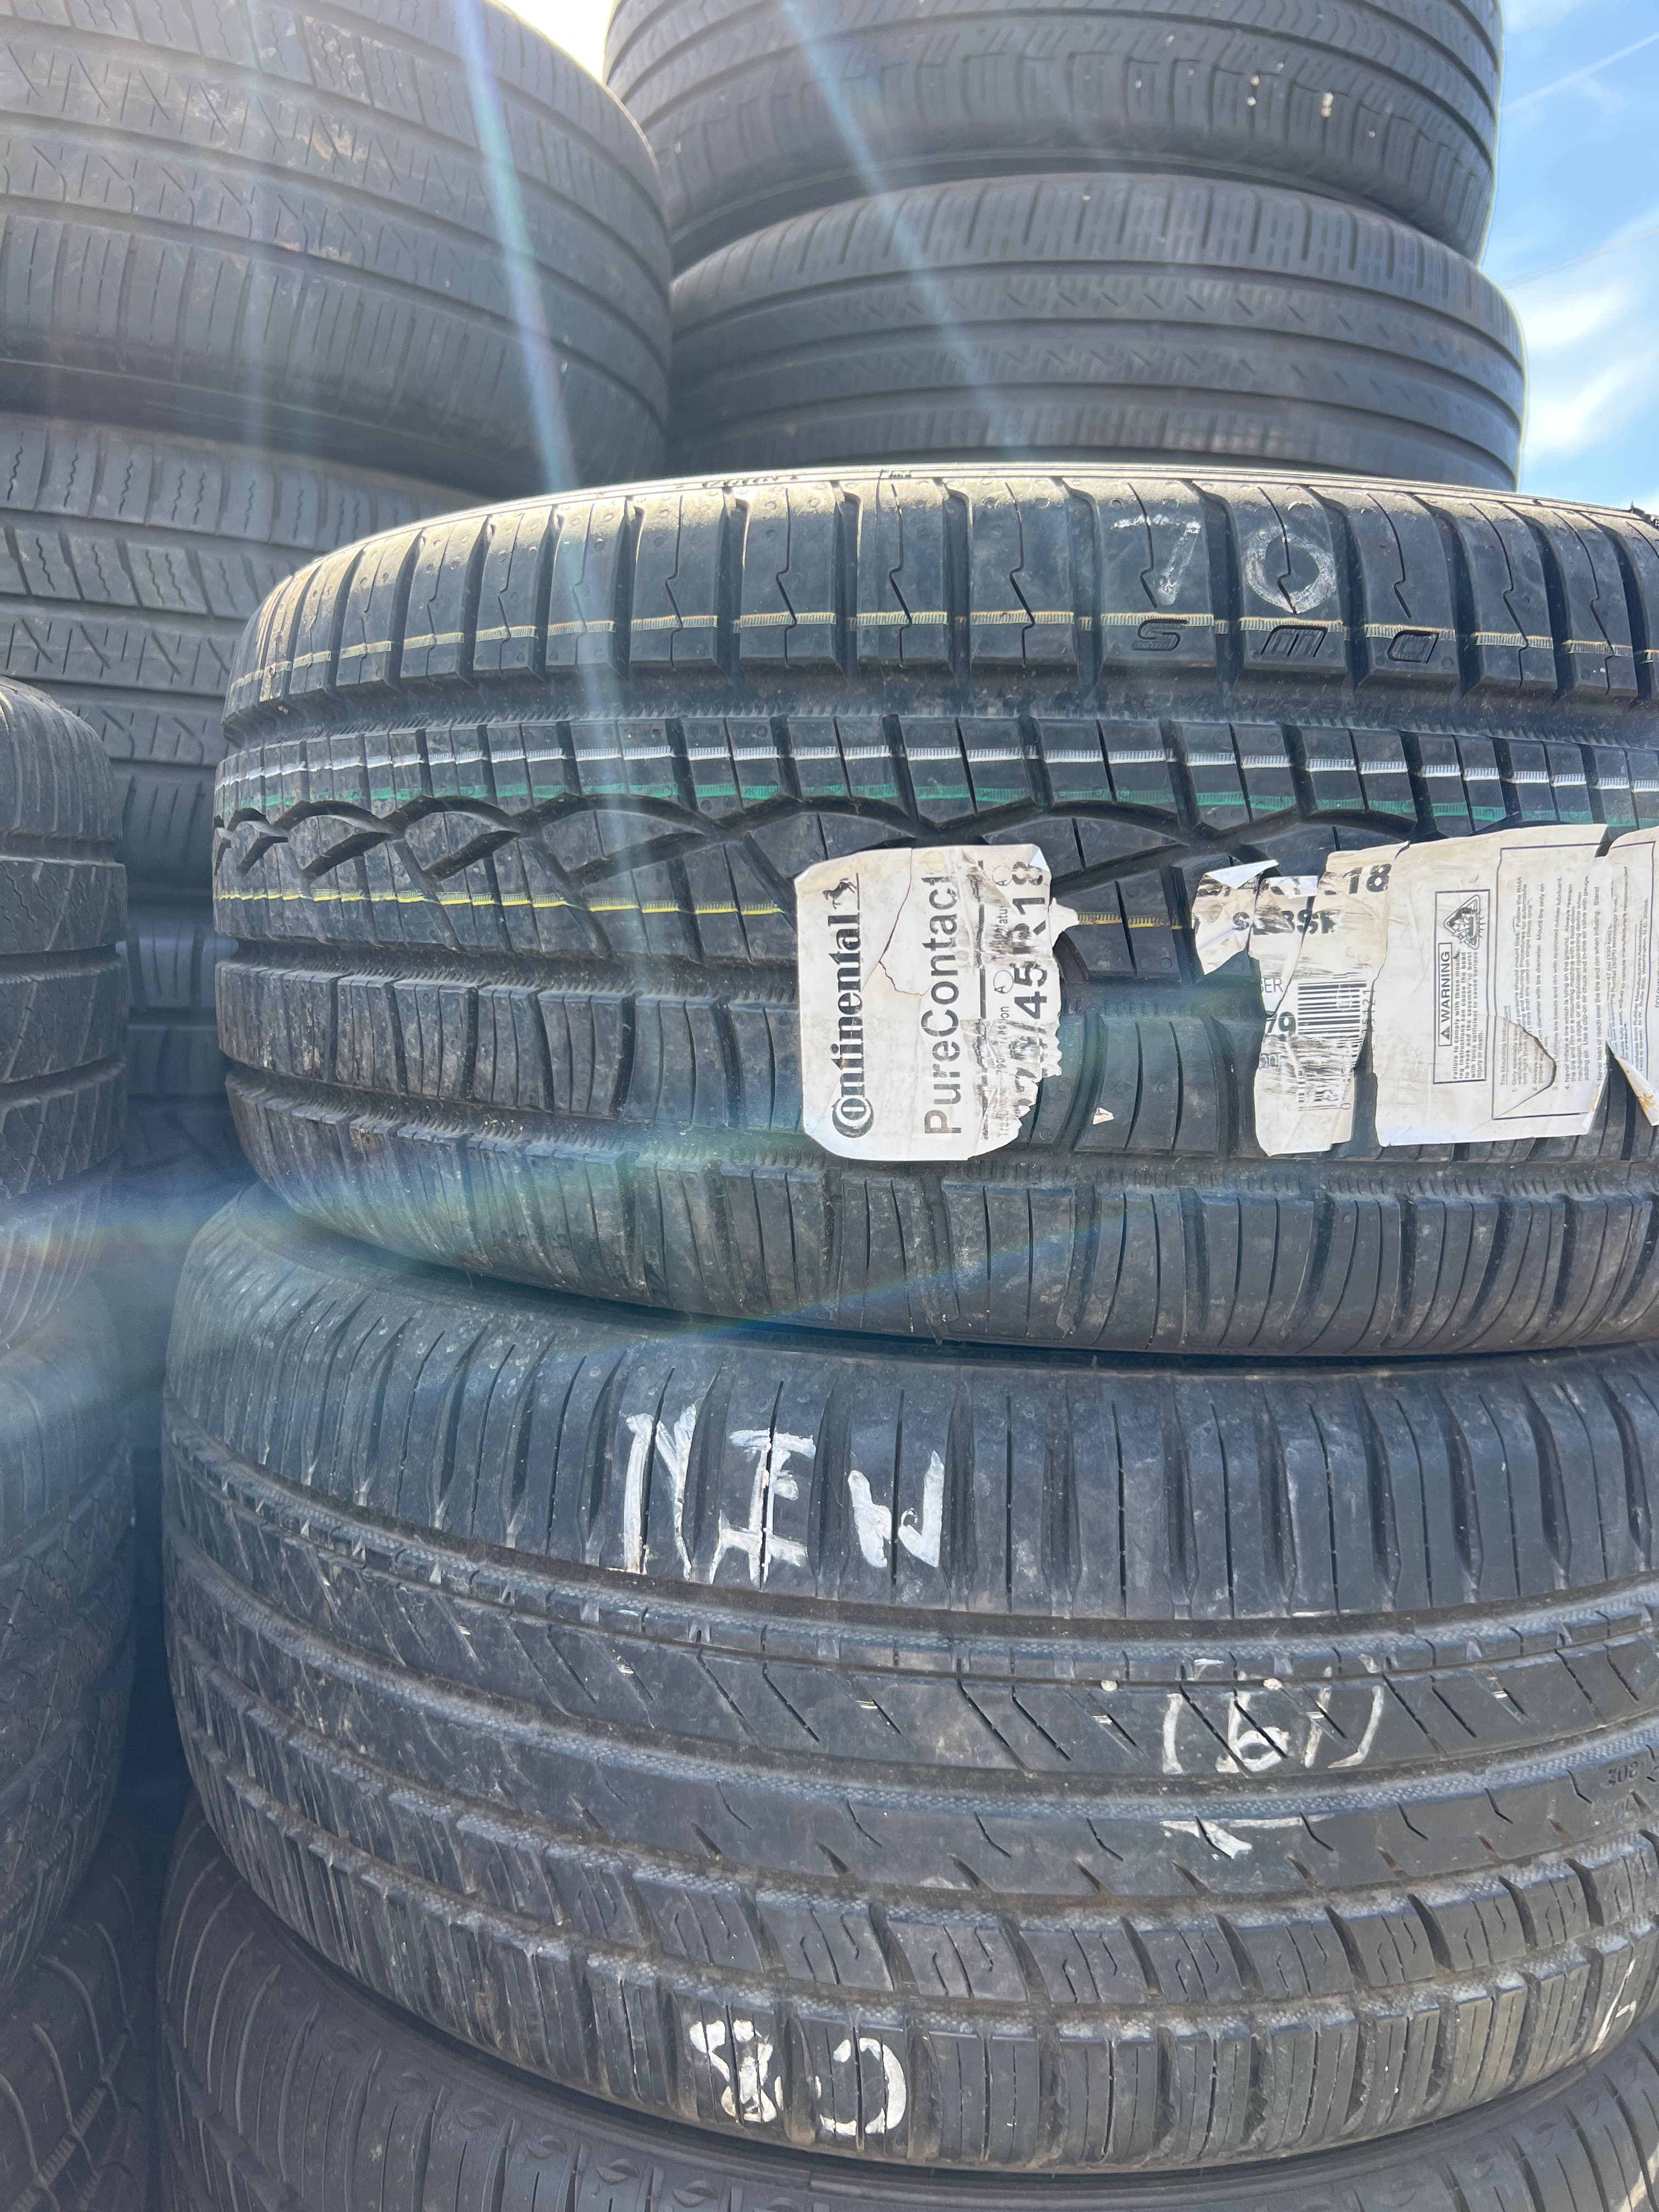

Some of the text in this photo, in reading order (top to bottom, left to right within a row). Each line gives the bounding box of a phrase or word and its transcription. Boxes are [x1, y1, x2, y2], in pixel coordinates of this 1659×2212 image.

[828, 913, 873, 1138] Continental
[922, 877, 961, 1134] PureContact
[1441, 951, 1450, 1023] WARNING
[623, 1403, 945, 1585] NEW
